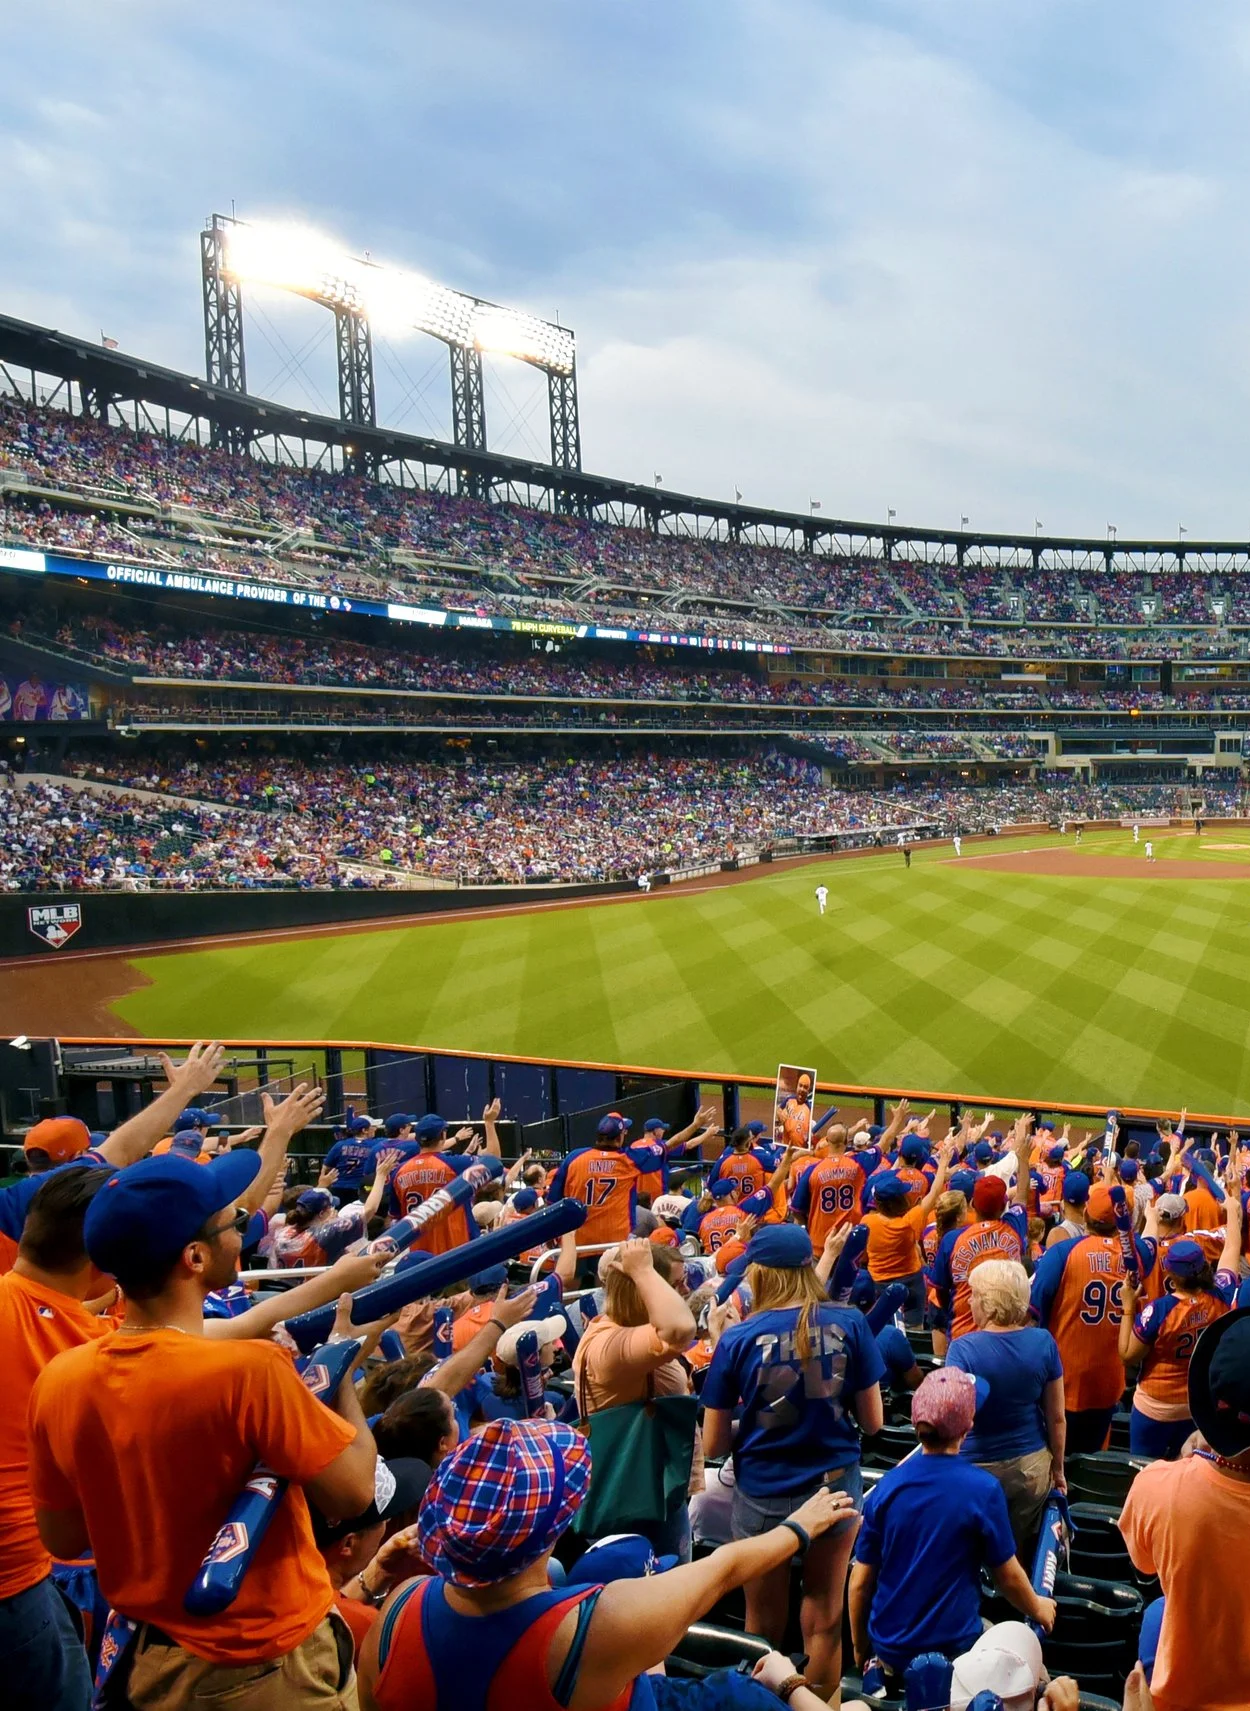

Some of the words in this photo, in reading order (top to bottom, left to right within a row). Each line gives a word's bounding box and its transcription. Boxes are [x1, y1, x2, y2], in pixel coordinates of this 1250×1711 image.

[107, 565, 163, 586] OFFICIAL
[165, 573, 233, 596] AMBULANCE
[236, 583, 287, 603] PROVIDER
[292, 593, 306, 604] OF
[308, 594, 326, 608] THE
[522, 622, 538, 633] MPH
[539, 624, 577, 635] CURVEBALL
[32, 906, 78, 922] MLB
[585, 1177, 617, 1207] 17
[820, 1184, 854, 1214] 88
[1118, 1229, 1134, 1260] ARMY
[1087, 1252, 1112, 1273] THE
[1080, 1279, 1125, 1326] 99
